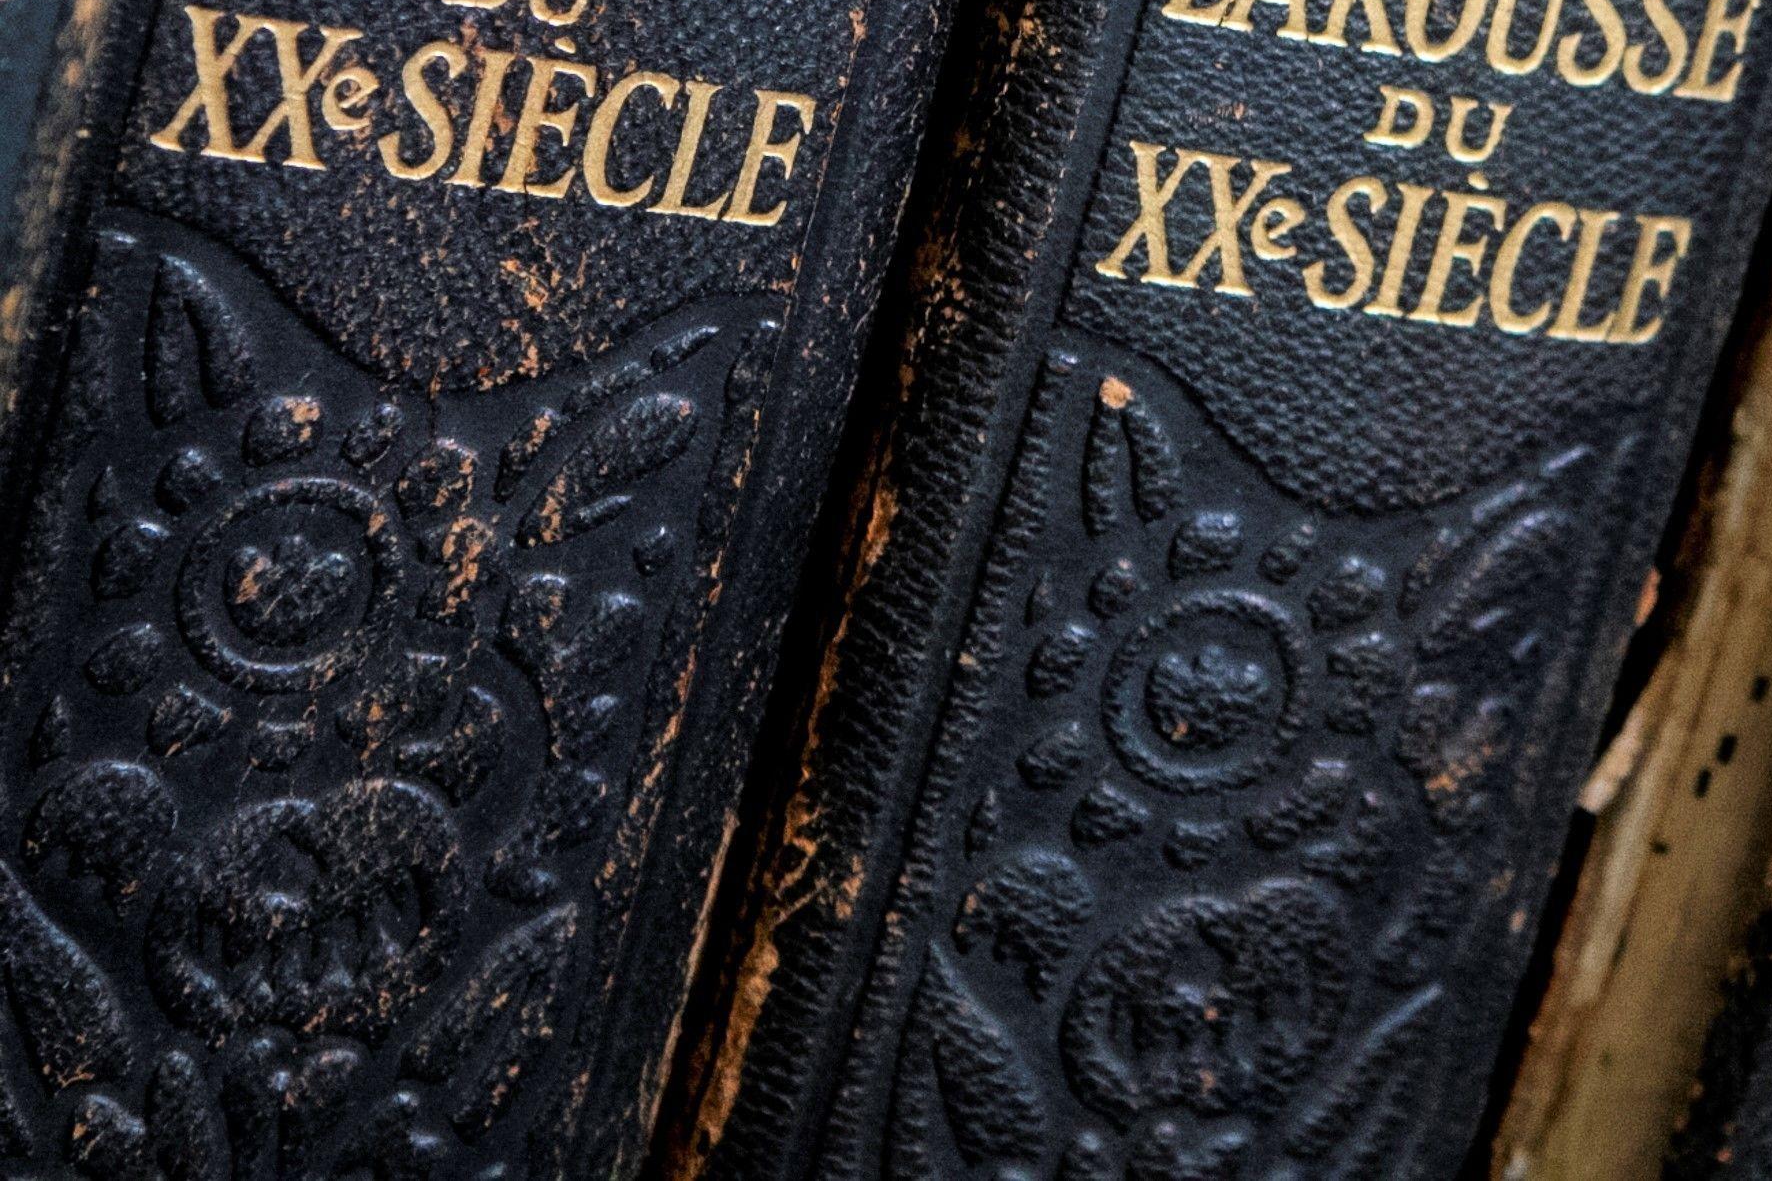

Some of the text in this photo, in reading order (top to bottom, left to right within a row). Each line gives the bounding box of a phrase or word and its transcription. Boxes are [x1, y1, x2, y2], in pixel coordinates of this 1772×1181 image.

[149, 5, 820, 227] XXe SIÈCLE
[1363, 84, 1514, 163] DU
[1094, 140, 1693, 345] XXe SIÈCLE
